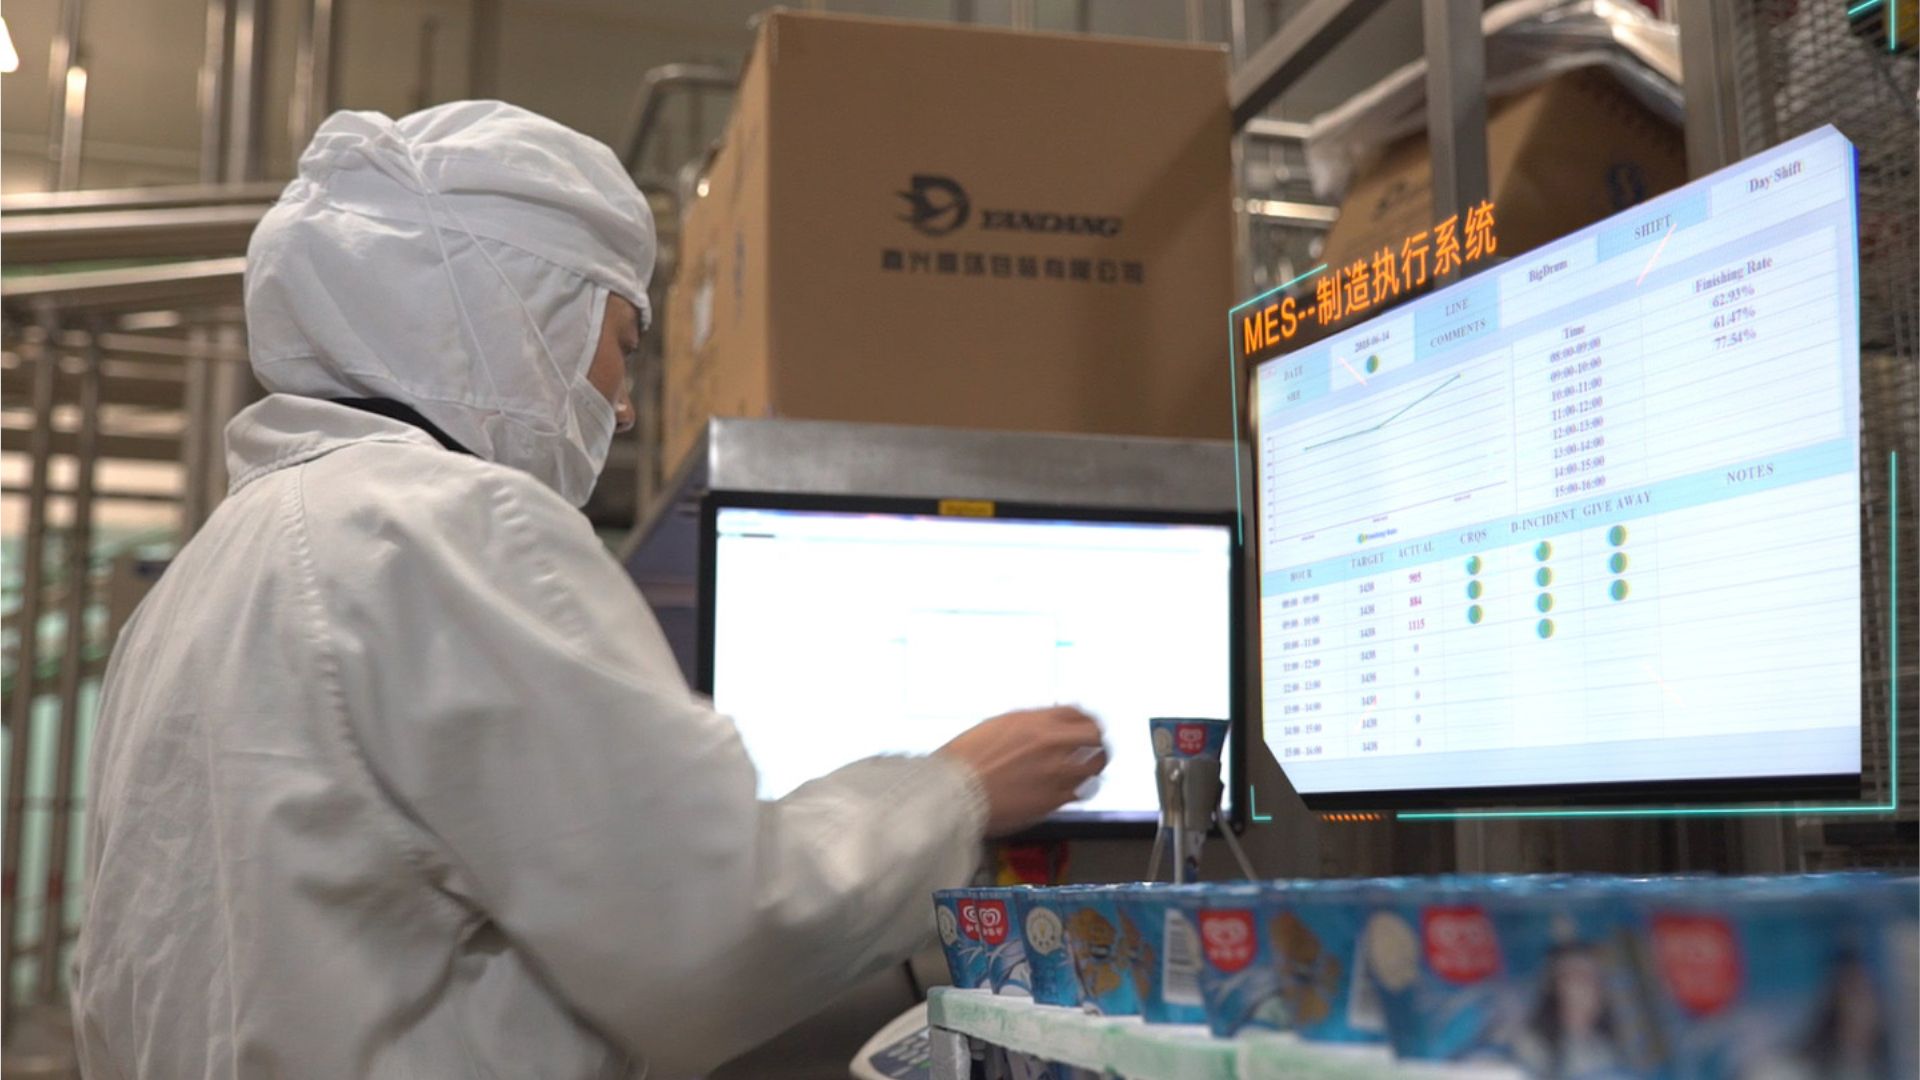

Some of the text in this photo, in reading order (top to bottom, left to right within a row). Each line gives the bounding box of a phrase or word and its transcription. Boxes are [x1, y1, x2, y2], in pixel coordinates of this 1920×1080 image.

[1749, 160, 1803, 192] Day Shift
[1634, 214, 1673, 240] SHIFT
[1528, 258, 1568, 284] BigDrum
[1694, 256, 1774, 294] Finishing Rate
[1445, 299, 1469, 317] LINE
[1713, 307, 1757, 329] 61.47%
[1430, 318, 1487, 349] COMMENTS
[1563, 324, 1586, 340] Time
[1714, 328, 1757, 350] 77.54%
[1727, 463, 1775, 485] NOTES
[1583, 491, 1653, 517] GIVE AWAY
[1511, 508, 1577, 533] D-INCIDENT
[1460, 528, 1488, 544] CRQS
